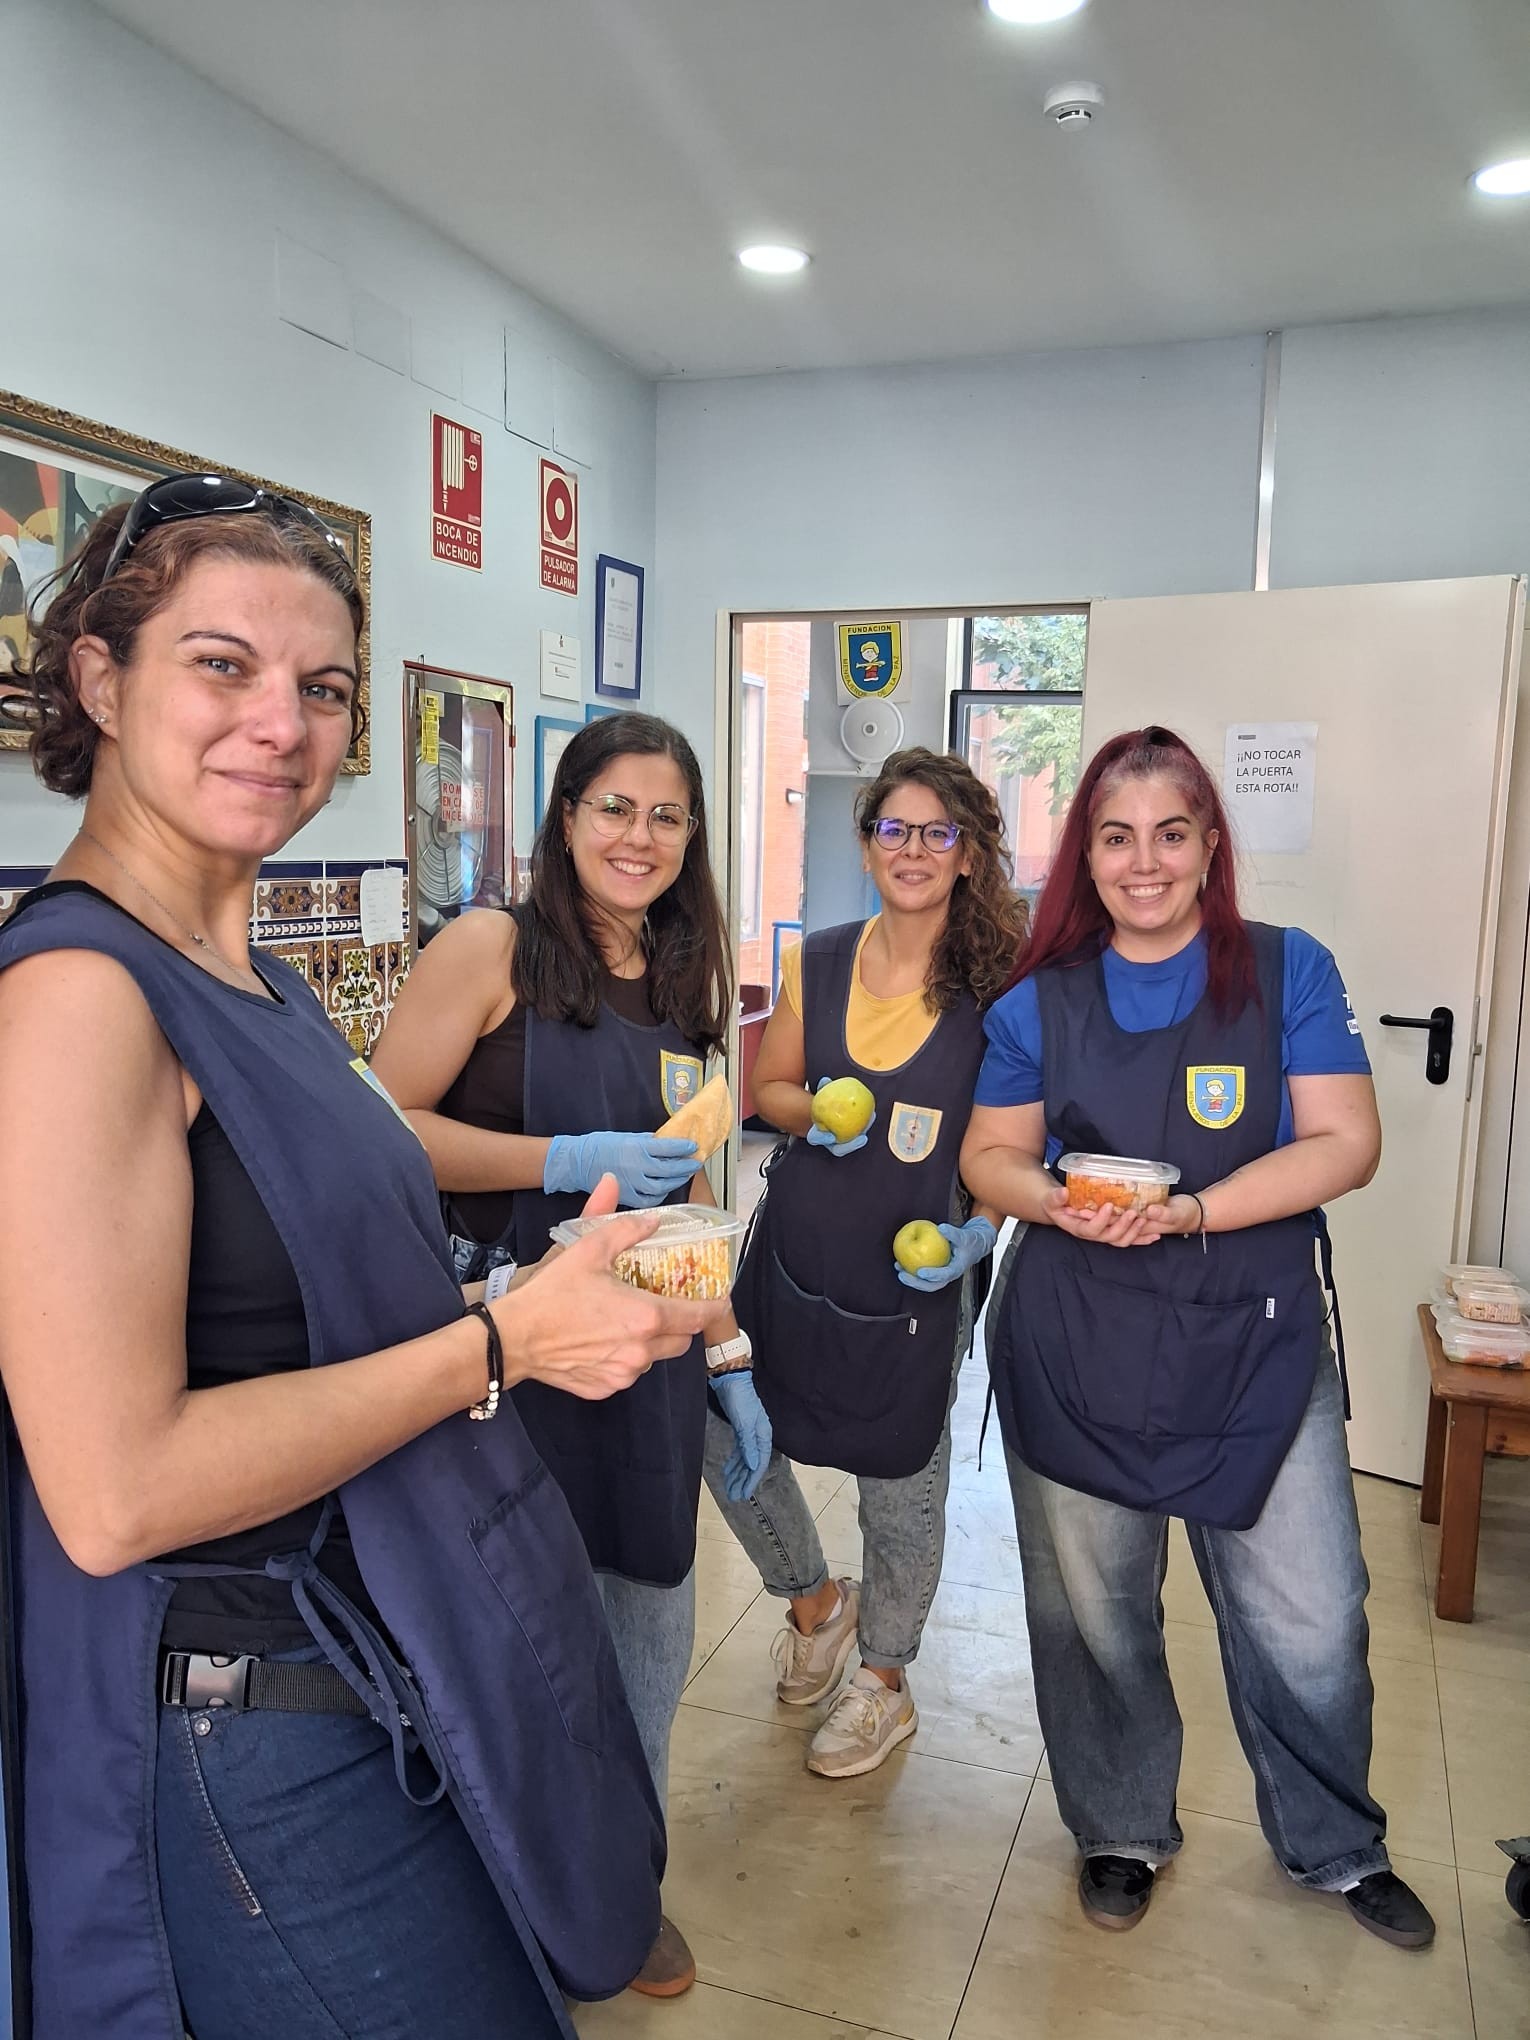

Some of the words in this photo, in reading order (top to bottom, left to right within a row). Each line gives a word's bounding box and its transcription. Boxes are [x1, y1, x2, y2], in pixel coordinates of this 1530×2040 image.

[436, 521, 462, 542] BOCA
[466, 530, 479, 547] DE
[436, 539, 478, 565] INCENDIO
[544, 554, 575, 575] PULSADOR
[543, 570, 552, 584] DE
[552, 573, 576, 592] ALARMA
[848, 625, 891, 633] FUNDACION
[1237, 751, 1261, 763] ¡¡NO
[1264, 750, 1302, 760] TOCAR
[1236, 767, 1249, 777] LA
[1252, 766, 1294, 777] PUERTA
[1235, 784, 1261, 793] ESTA
[1263, 783, 1299, 793] ROTA!!
